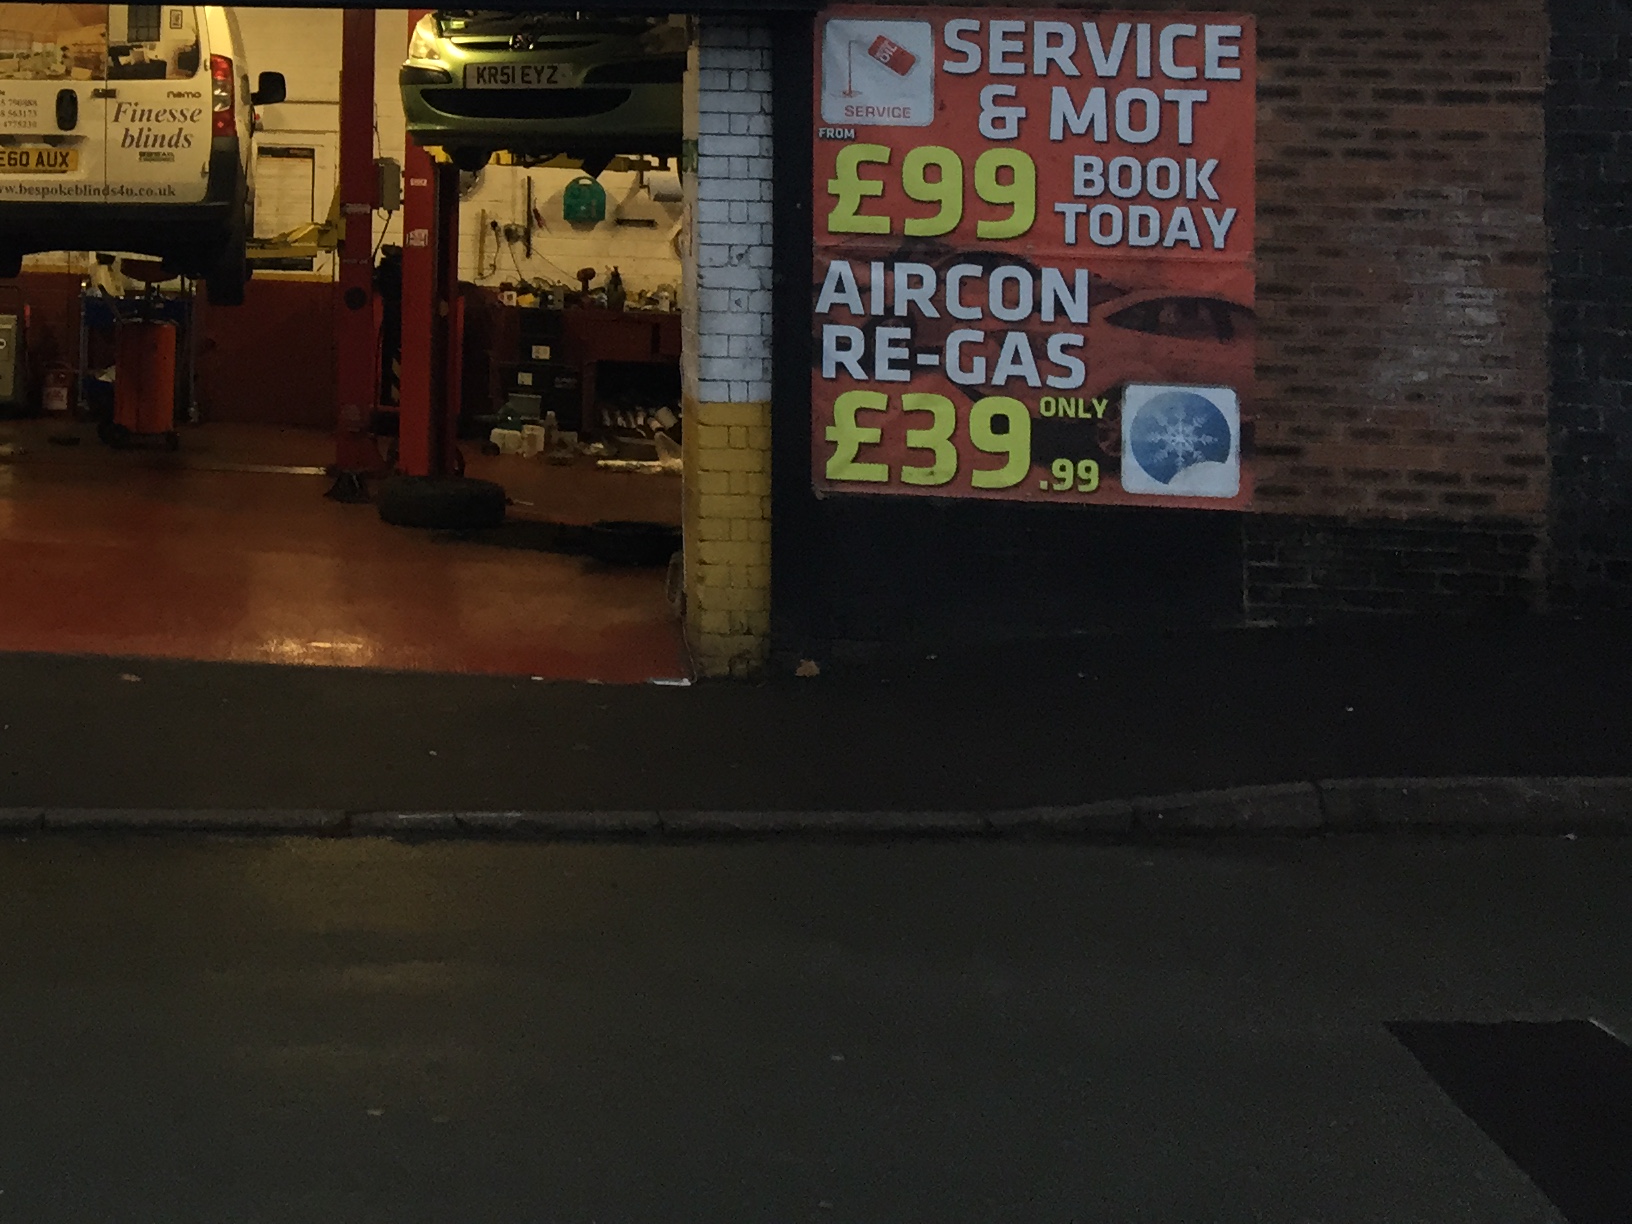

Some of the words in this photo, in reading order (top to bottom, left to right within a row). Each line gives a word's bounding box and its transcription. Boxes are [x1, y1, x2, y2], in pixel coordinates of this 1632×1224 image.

[941, 18, 1243, 81] SERVICE
[520, 65, 559, 85] EYZ
[111, 100, 203, 124] Finesse
[843, 103, 912, 120] SERVICE
[977, 83, 1027, 141] &
[1049, 85, 1209, 145] MOT
[120, 126, 195, 149] blinds
[818, 127, 856, 141] FROM
[35, 150, 70, 168] AUX
[1072, 154, 1220, 201] BOOK
[826, 142, 1038, 240] £99
[1054, 202, 1237, 250] TODAY
[814, 259, 1090, 324] AIRCON
[821, 323, 1086, 390] RE-GAS
[1039, 396, 1109, 419] ONLY
[824, 389, 1033, 490] £39
[1039, 458, 1101, 493] .99
